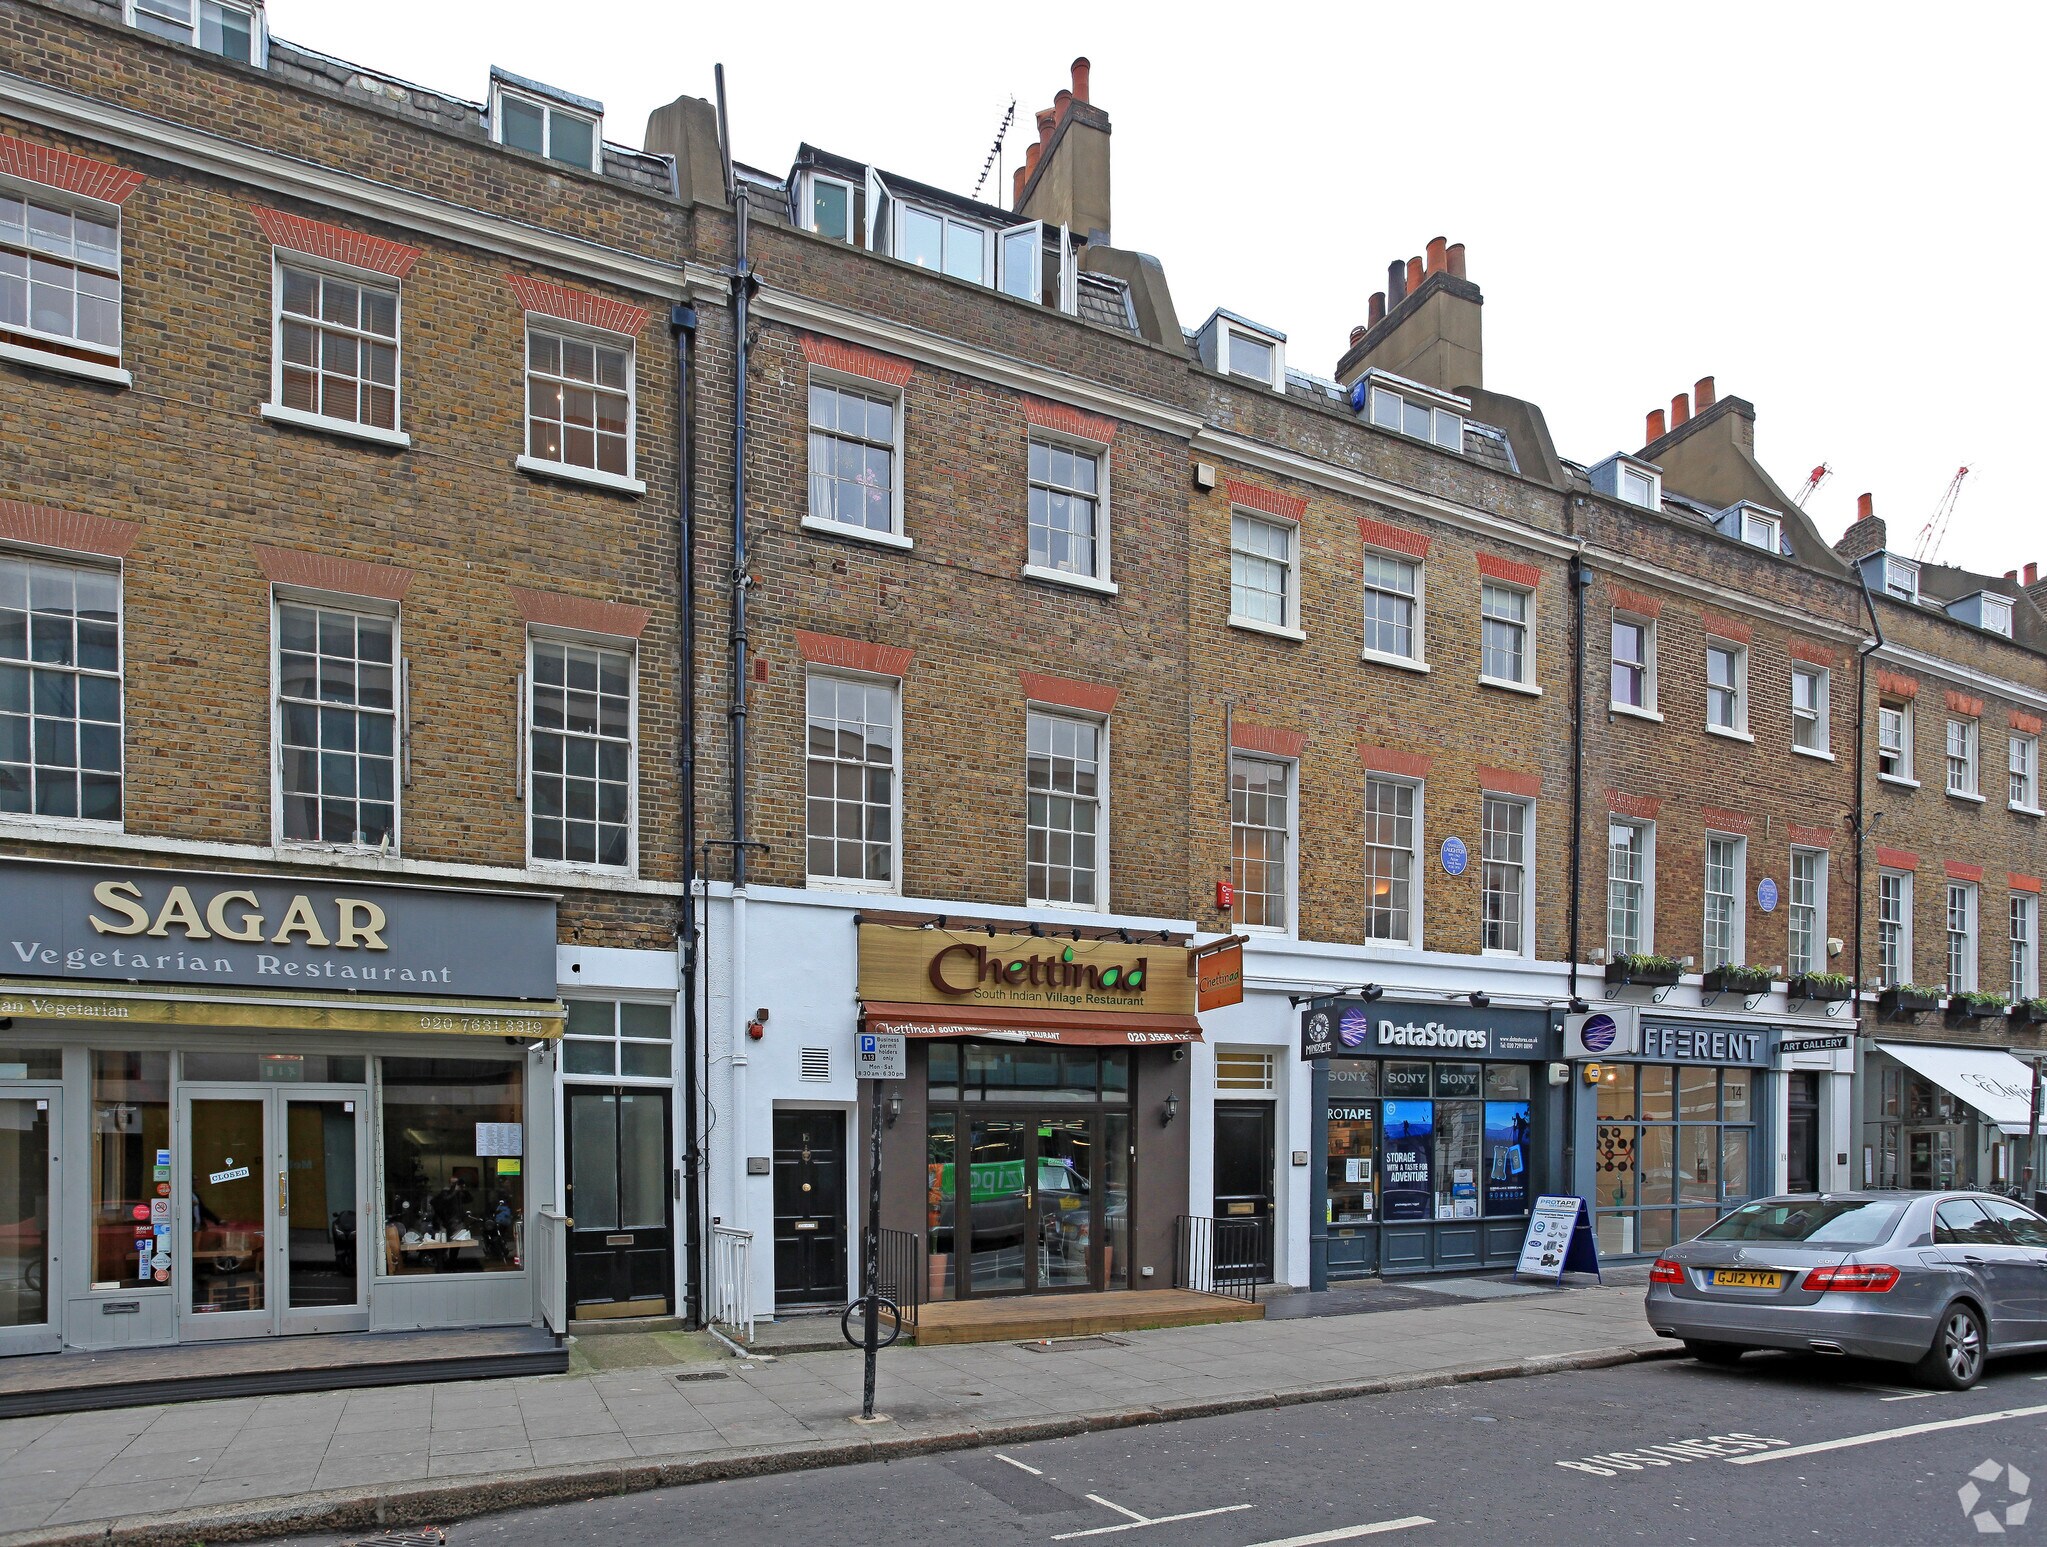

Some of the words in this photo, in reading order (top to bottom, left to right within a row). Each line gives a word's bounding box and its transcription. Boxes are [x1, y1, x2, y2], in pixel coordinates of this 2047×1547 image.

[89, 881, 389, 950] SAGAR
[11, 941, 234, 971] Vegetarian
[257, 954, 452, 984] Restaurant
[929, 943, 1148, 997] Chettinad
[1200, 969, 1239, 993] Chettinad
[973, 988, 1006, 999] South
[1009, 989, 1042, 1001] Indian
[1045, 992, 1082, 1005] Village
[1085, 993, 1144, 1006] Restaurant
[31, 999, 129, 1018] Vegetarian
[420, 1016, 453, 1030] 020
[460, 1018, 500, 1032] 7631
[505, 1020, 542, 1034] 3319
[875, 1022, 935, 1034] Chettinad
[938, 1026, 963, 1034] SOUTH
[1127, 1032, 1147, 1042] 020
[1378, 1019, 1487, 1048] DataStores
[864, 1037, 874, 1051] P
[1783, 1040, 1801, 1051] ART
[1802, 1038, 1843, 1050] GALLERY
[1328, 1071, 1368, 1082] SONY
[1388, 1072, 1427, 1084] SONY
[1440, 1073, 1477, 1085] SONY
[1731, 1086, 1742, 1100] 14
[1386, 1152, 1416, 1163] STORAGE
[1386, 1163, 1399, 1171] WITH
[1404, 1163, 1419, 1171] TASTE
[1419, 1163, 1428, 1171] FOR
[211, 1169, 248, 1182] CLOSED
[1391, 1171, 1429, 1182] ADVENTURE
[1717, 1271, 1746, 1285] GJ12
[1750, 1272, 1775, 1287] YYA
[1555, 1432, 1791, 1477] BUSINESS
